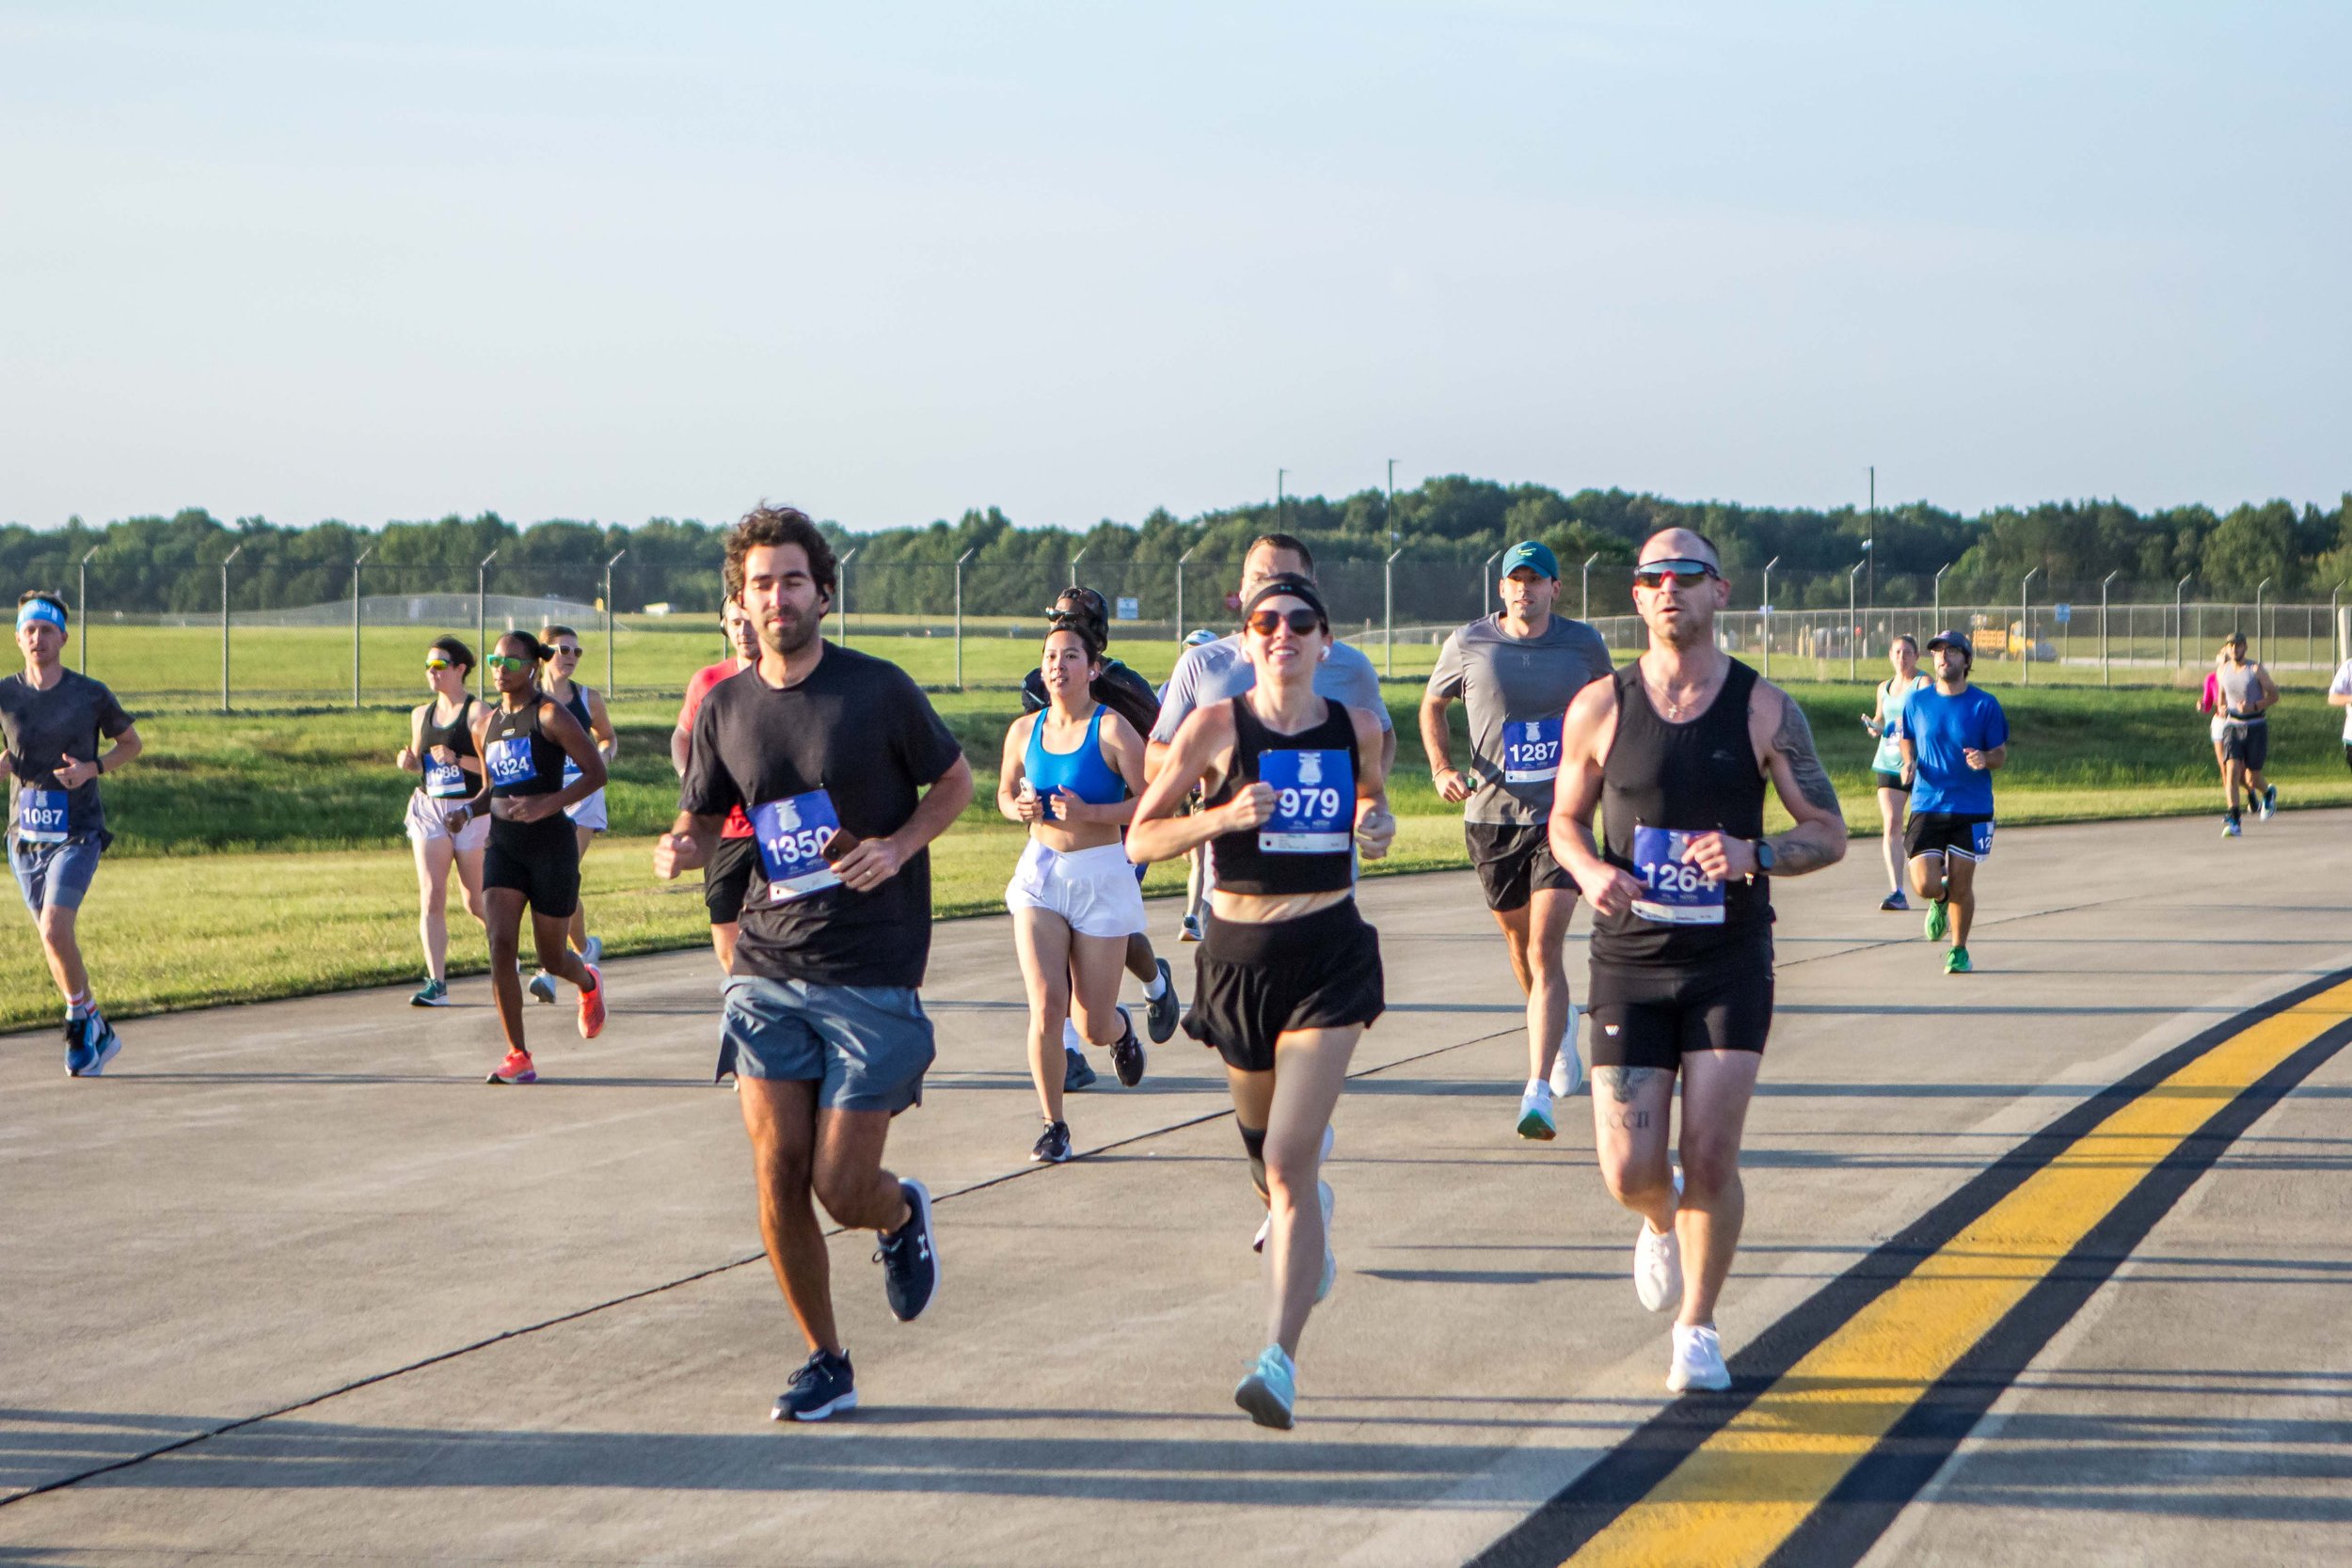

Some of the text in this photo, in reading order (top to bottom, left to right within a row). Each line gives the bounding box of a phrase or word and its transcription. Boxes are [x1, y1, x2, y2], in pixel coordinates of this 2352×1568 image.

[1509, 741, 1558, 762] 1287
[491, 756, 530, 777] 1324
[1279, 787, 1340, 817] 979
[23, 807, 63, 825] 1087
[767, 826, 834, 865] 1350
[1642, 862, 1717, 892] 1264
